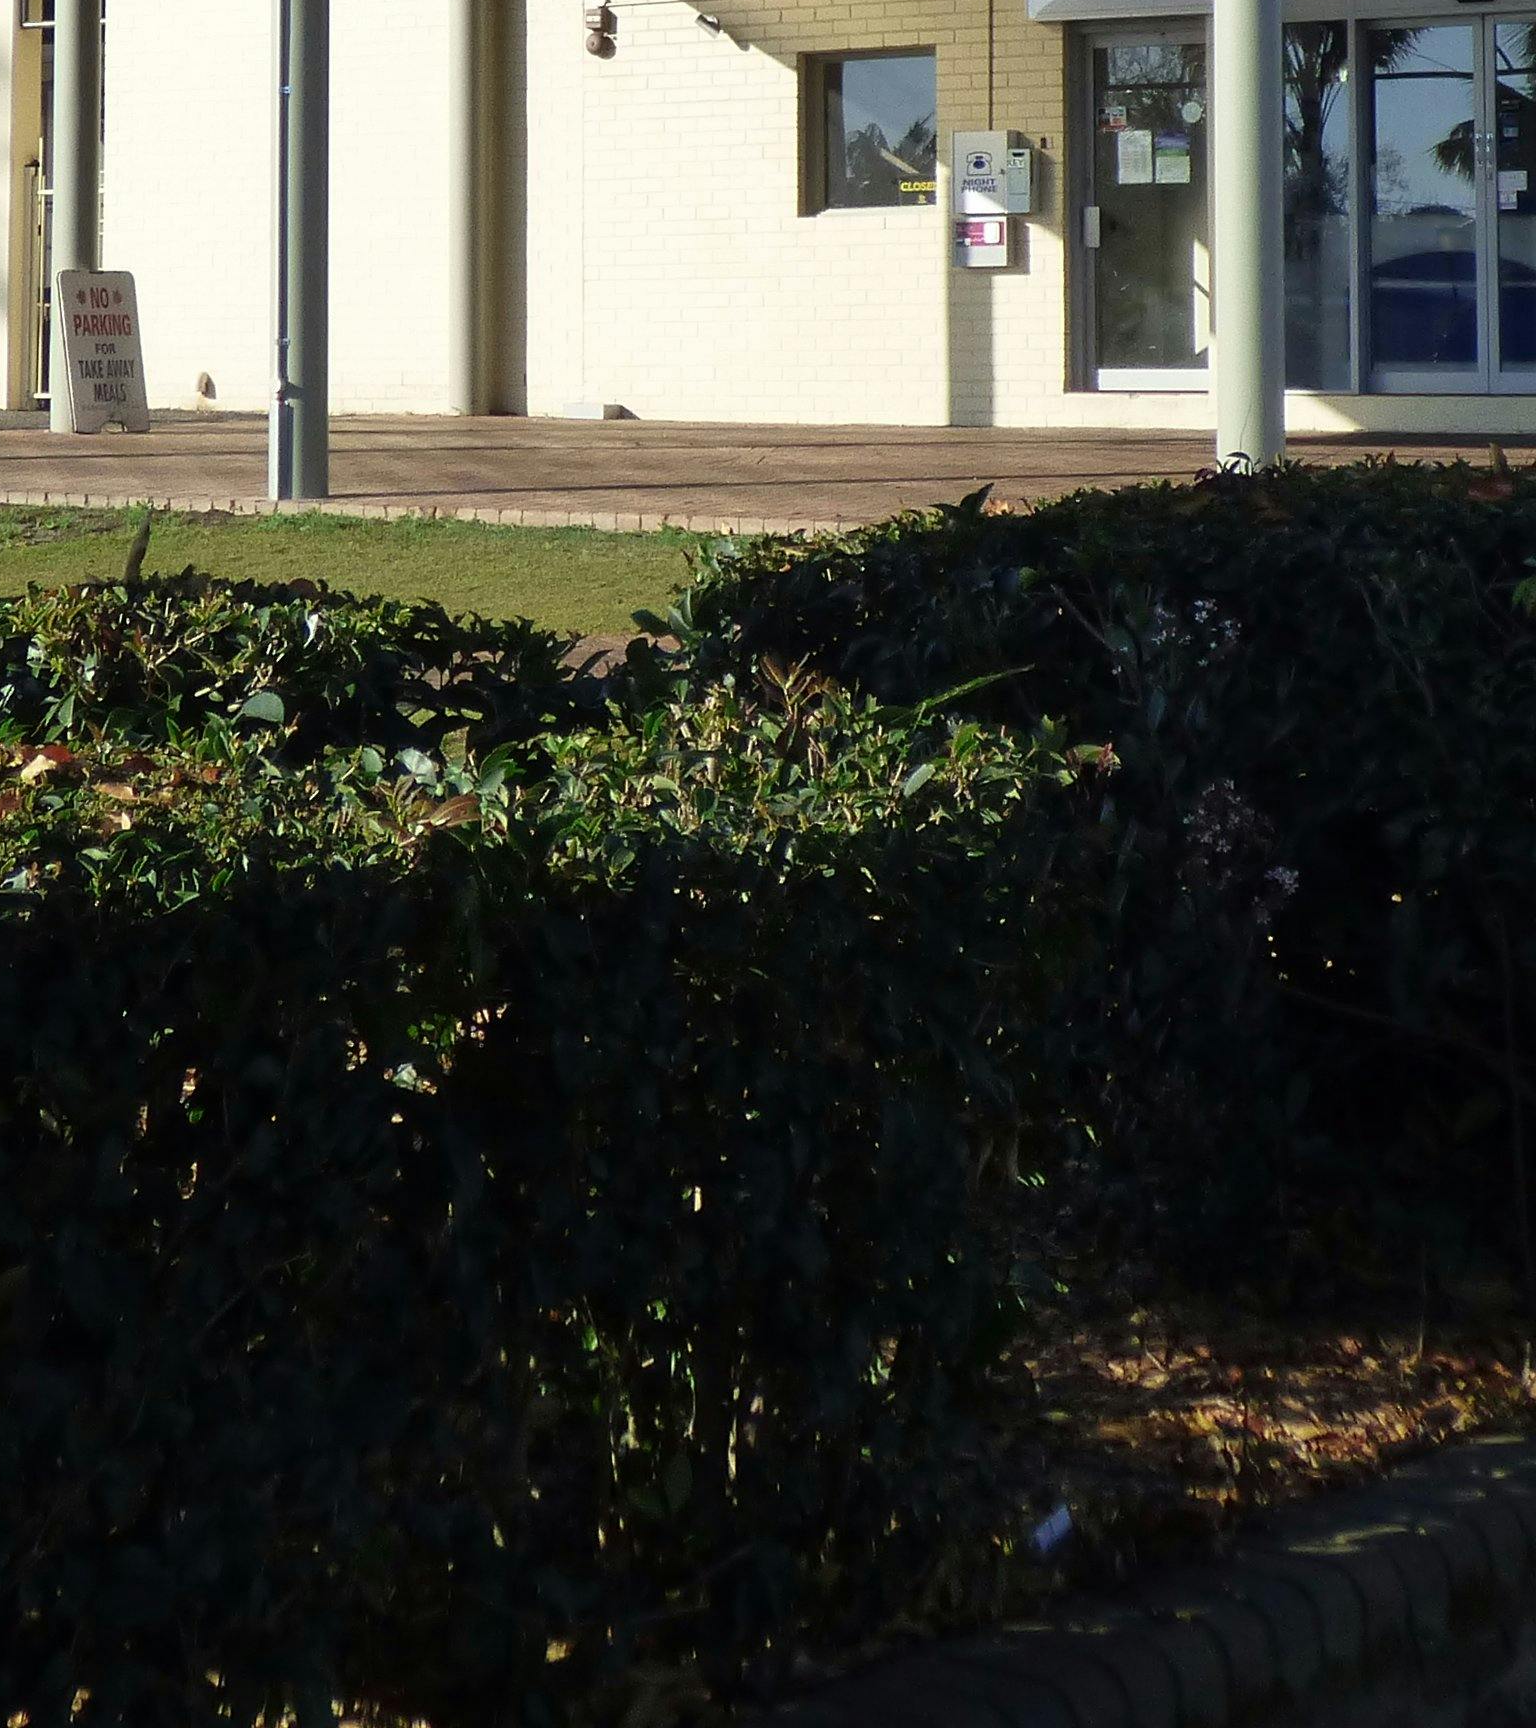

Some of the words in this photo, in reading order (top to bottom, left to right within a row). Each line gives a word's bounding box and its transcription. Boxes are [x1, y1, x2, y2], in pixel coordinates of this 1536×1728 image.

[961, 185, 998, 193] PHONE
[90, 286, 110, 309] NO
[73, 314, 133, 337] PARKING
[95, 343, 117, 355] FOR
[78, 360, 104, 380] TAKE
[106, 359, 136, 379] AWAY
[94, 382, 128, 404] MEALS
